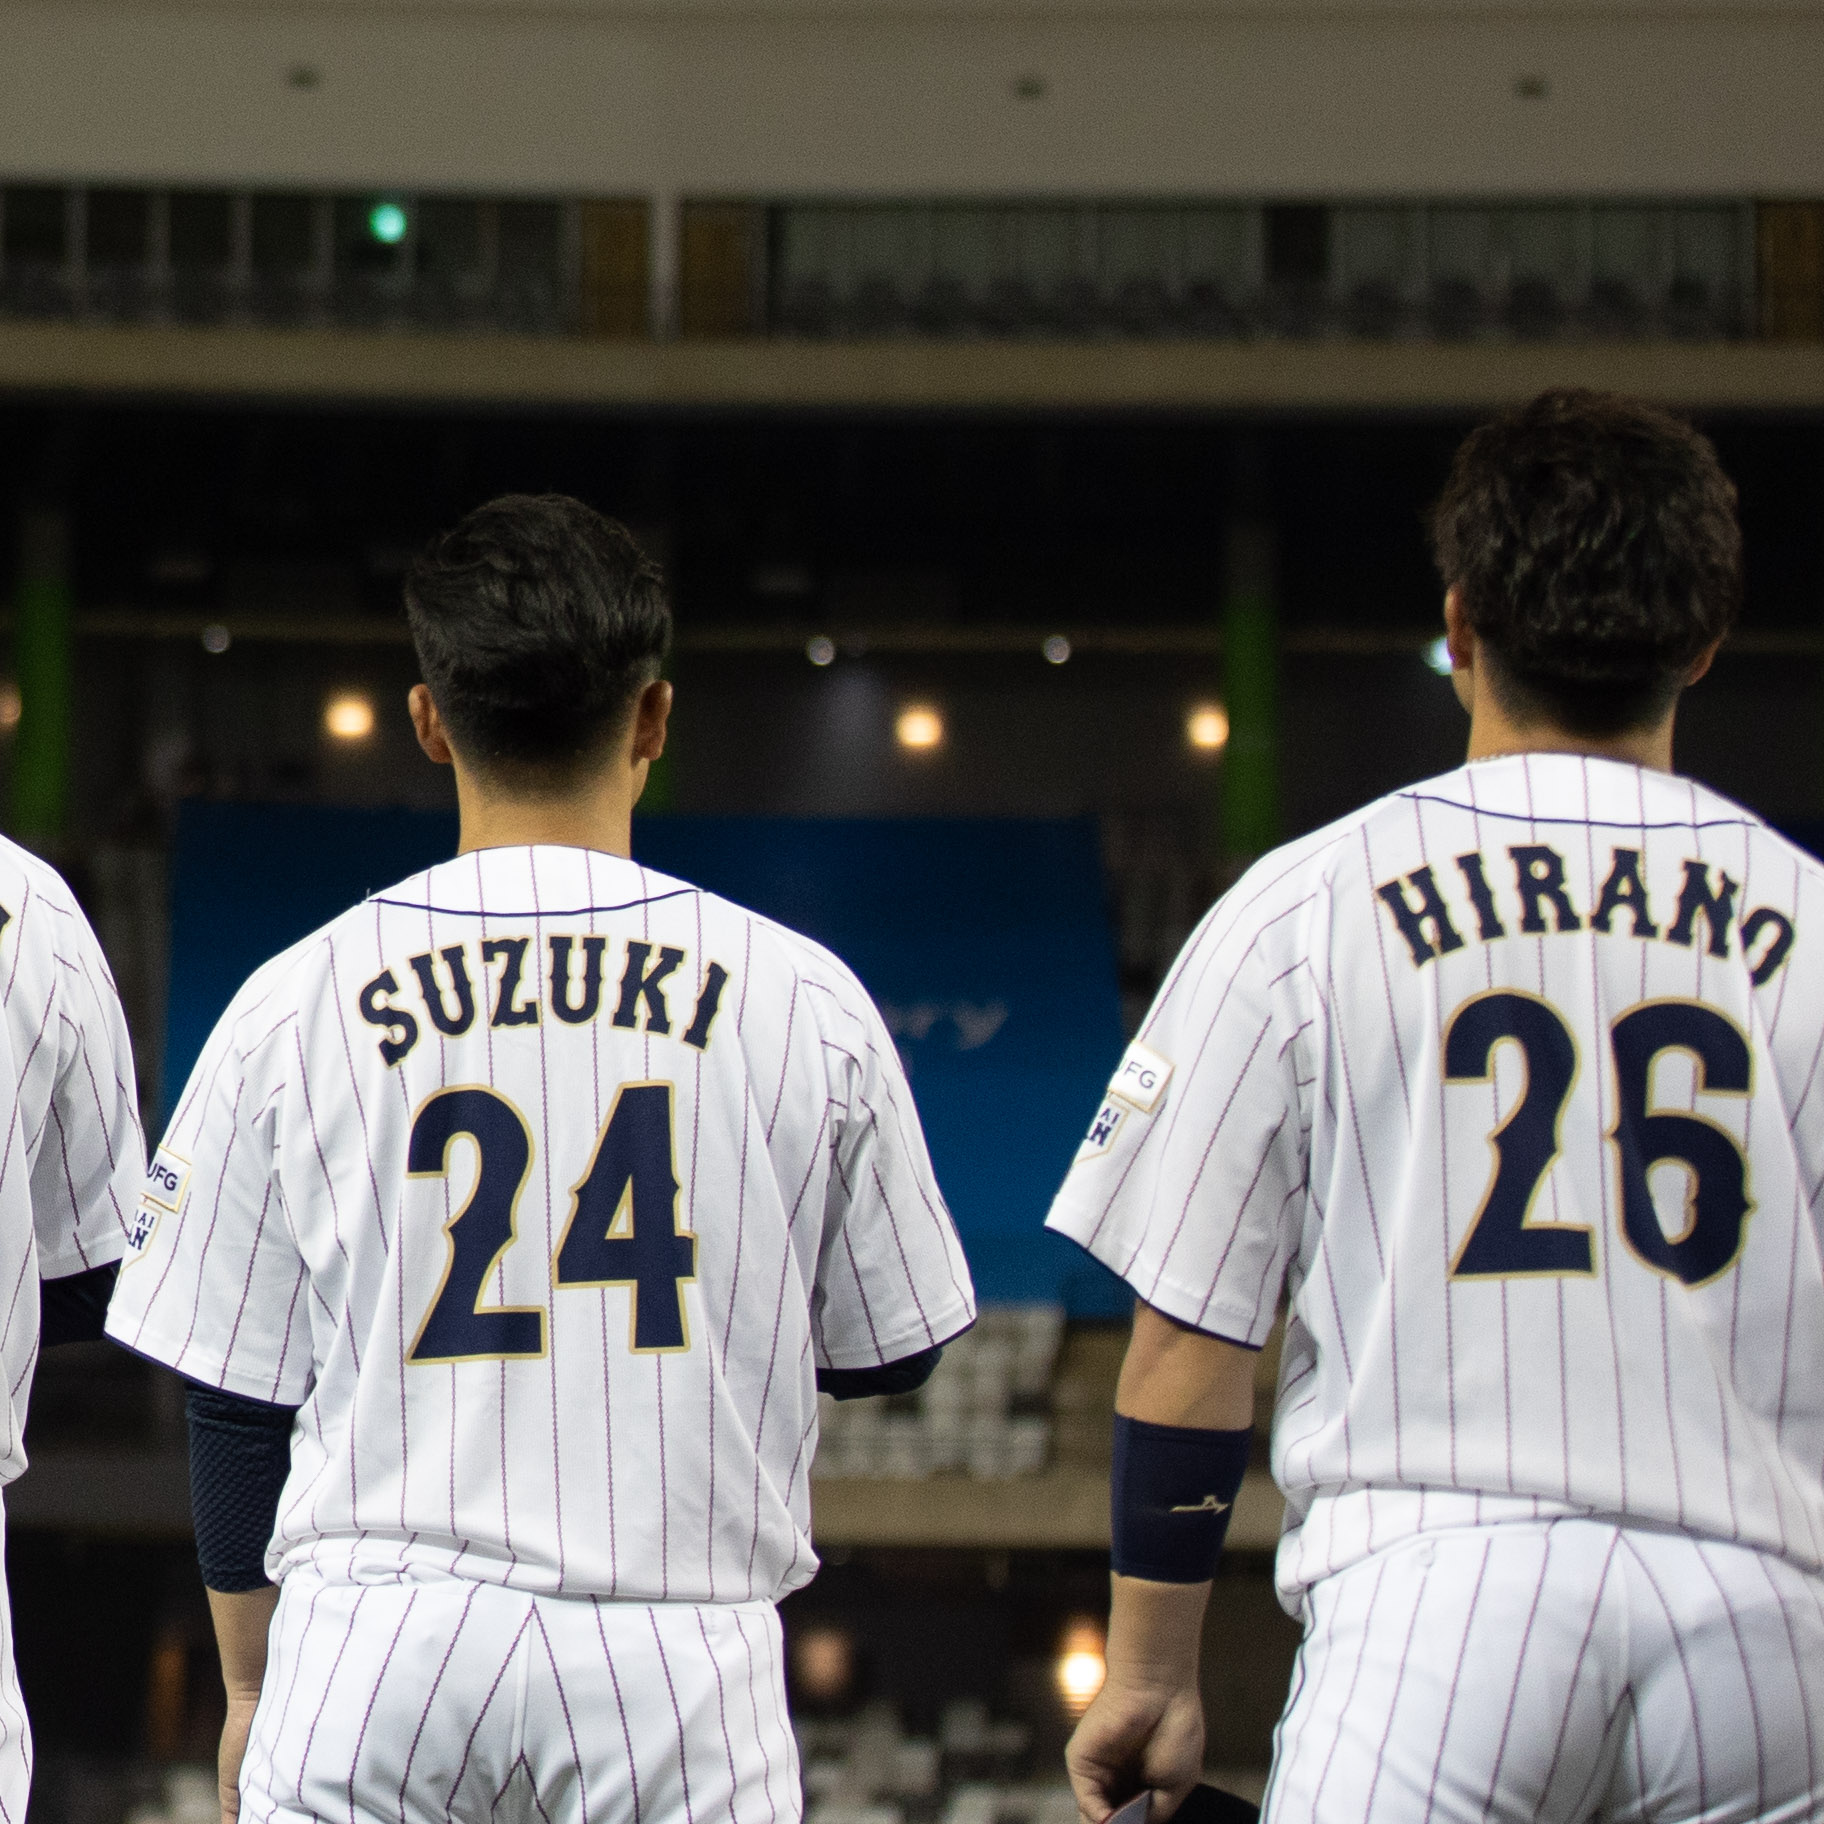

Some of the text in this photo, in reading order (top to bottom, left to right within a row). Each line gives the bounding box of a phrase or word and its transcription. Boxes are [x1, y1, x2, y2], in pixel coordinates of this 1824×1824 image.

[1375, 845, 1796, 989] HIRANO
[357, 933, 731, 1070] SUZUKI
[1120, 1059, 1157, 1089] FG
[1442, 987, 1758, 1291] 26
[404, 1079, 699, 1366] 24
